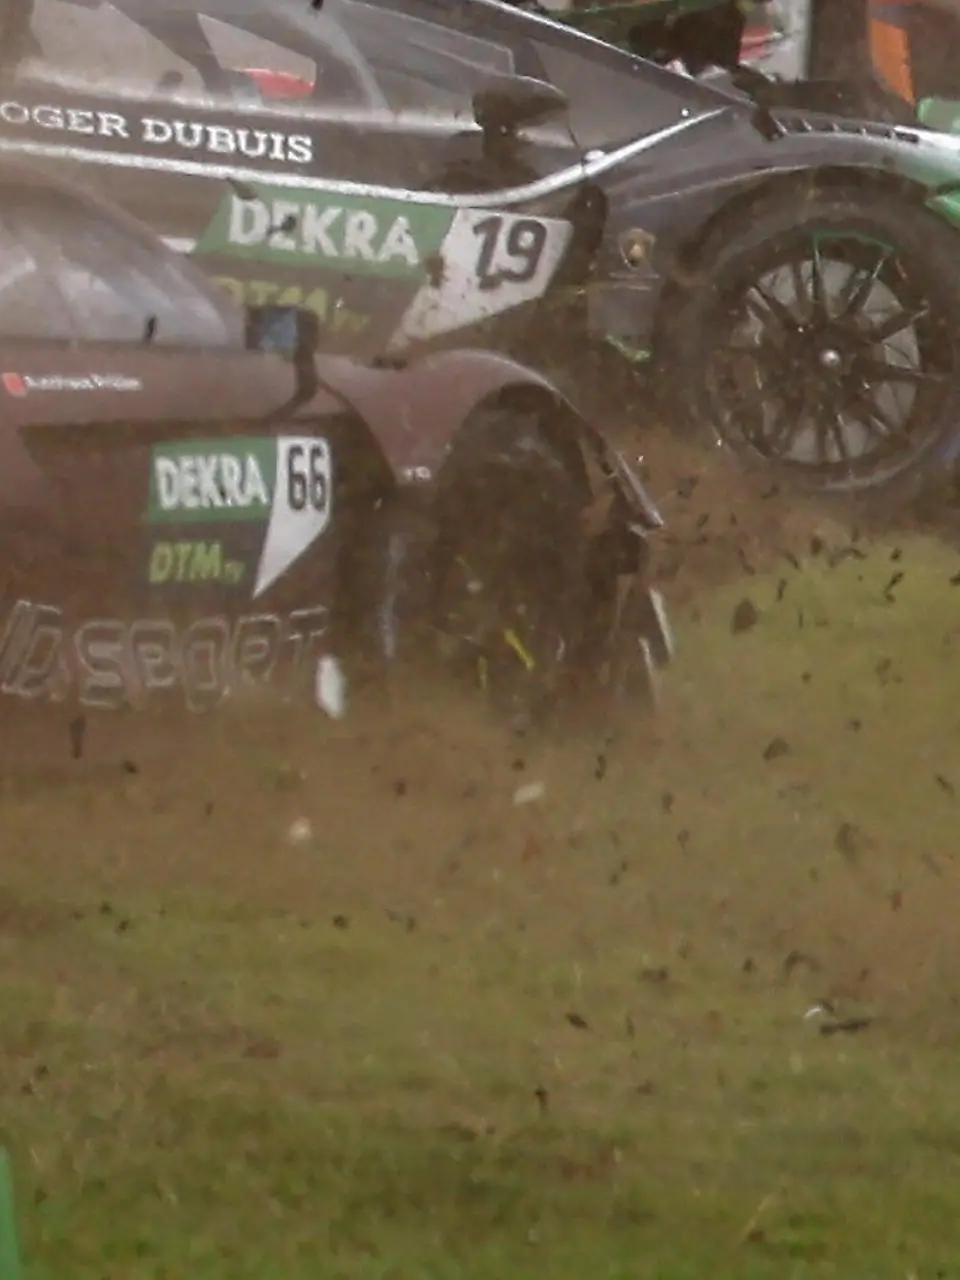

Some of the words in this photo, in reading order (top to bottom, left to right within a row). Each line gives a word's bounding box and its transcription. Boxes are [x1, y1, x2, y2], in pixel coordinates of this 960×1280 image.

[141, 118, 315, 164] DUBUIS
[228, 194, 419, 266] DEKRA
[473, 216, 547, 291] 19
[154, 452, 269, 511] DEKRA
[287, 444, 328, 512] 66
[149, 540, 222, 584] DTM
